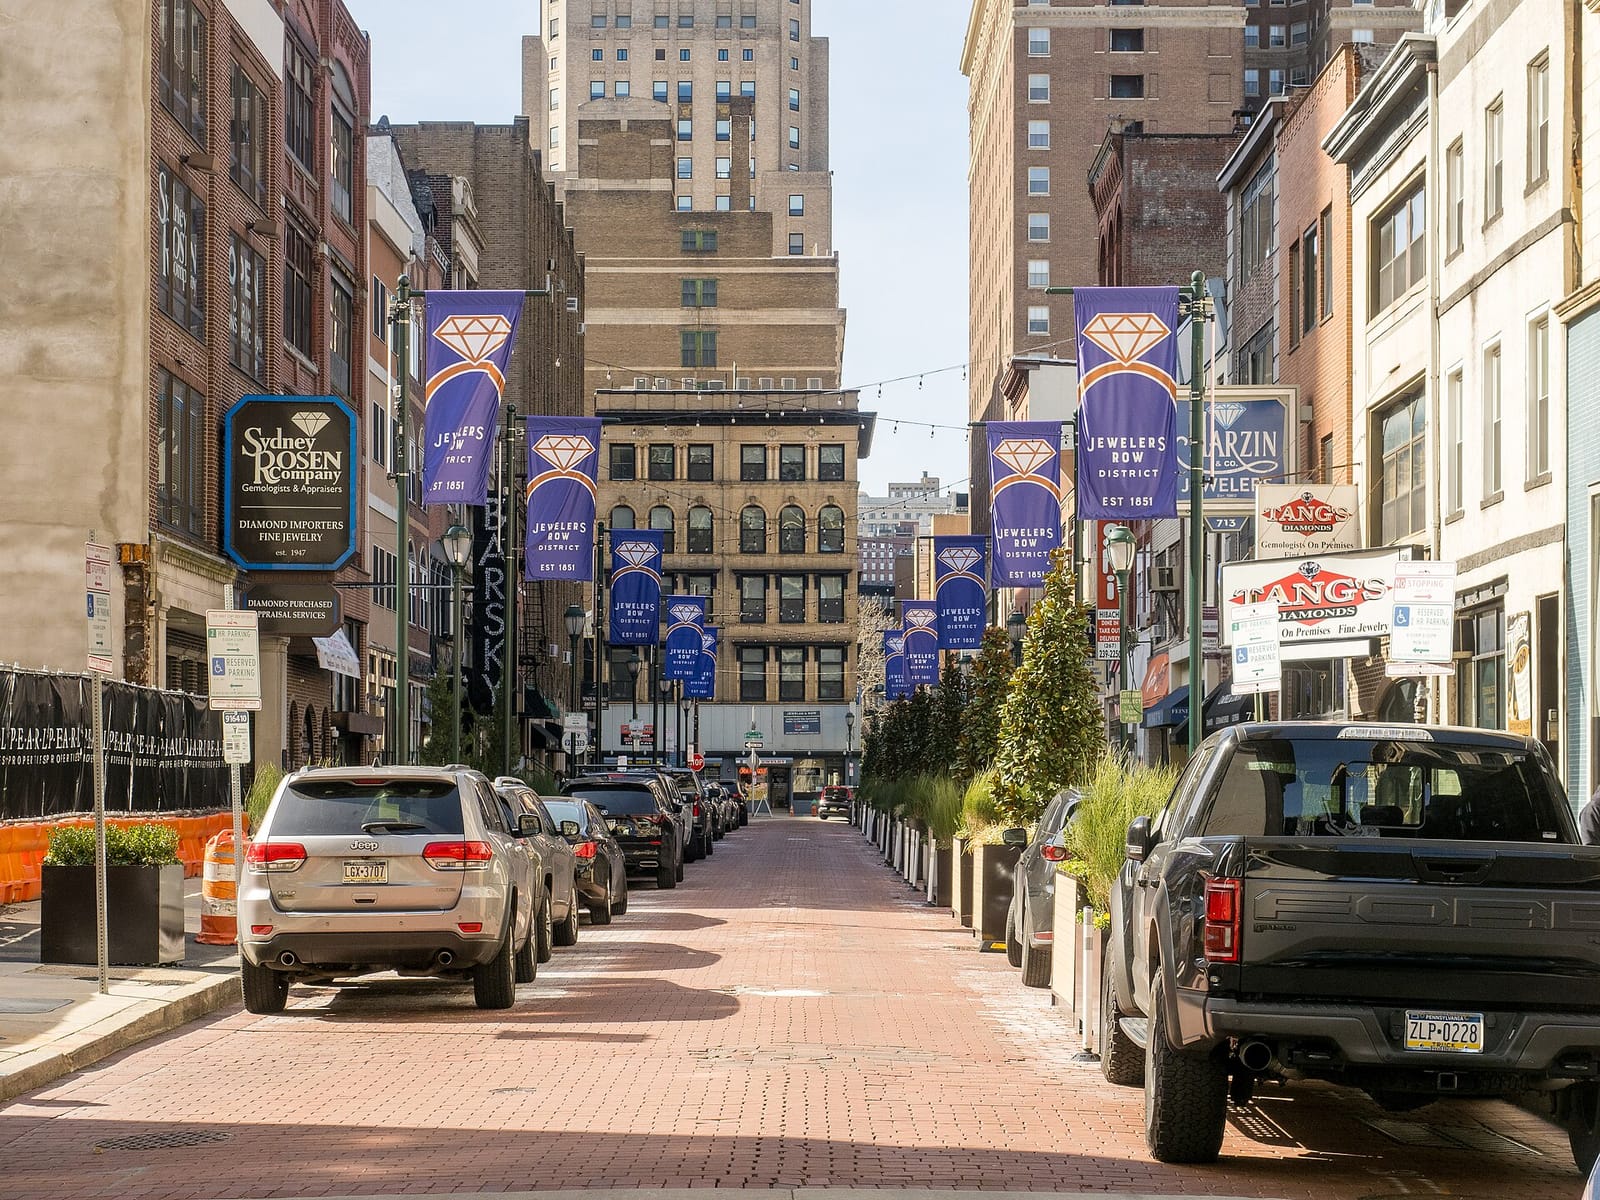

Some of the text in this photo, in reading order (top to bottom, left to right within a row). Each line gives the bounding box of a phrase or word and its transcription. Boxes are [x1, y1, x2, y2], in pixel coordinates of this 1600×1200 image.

[242, 427, 316, 456] Sydney
[1087, 436, 1166, 452] JEWELERS
[1112, 452, 1144, 463] ROW
[254, 450, 342, 484] ROSEN
[269, 466, 342, 485] Company
[242, 484, 343, 495] Gemologists & Appraisers
[430, 481, 464, 491] ST 1851
[1103, 497, 1153, 506] EST 1851
[1264, 505, 1351, 522] TANG'S
[240, 520, 344, 530] DIAMOND IMPORTERS
[532, 522, 586, 533] JEWELERS
[1216, 519, 1236, 527] 713
[259, 532, 323, 543] FINE JEWELRY
[547, 532, 569, 540] ROW
[996, 528, 1054, 539] JEWELERS
[1014, 539, 1037, 547] ROW
[1261, 541, 1305, 550] Gemologists
[1321, 541, 1354, 549] Premises
[1408, 579, 1444, 588] STOPPING
[1233, 578, 1388, 607] TANG'S
[248, 600, 333, 609] DIAMONDS PURCHASED
[479, 497, 507, 705] BARSKY
[615, 603, 655, 611] JEWELERS
[941, 608, 981, 616] JEWELERS
[257, 611, 291, 619] PPRAISAL
[1281, 621, 1390, 638] On Premises Fine Jewelry
[226, 658, 256, 666] RESERVED
[228, 668, 255, 676] PARKING
[350, 840, 378, 851] Jeep
